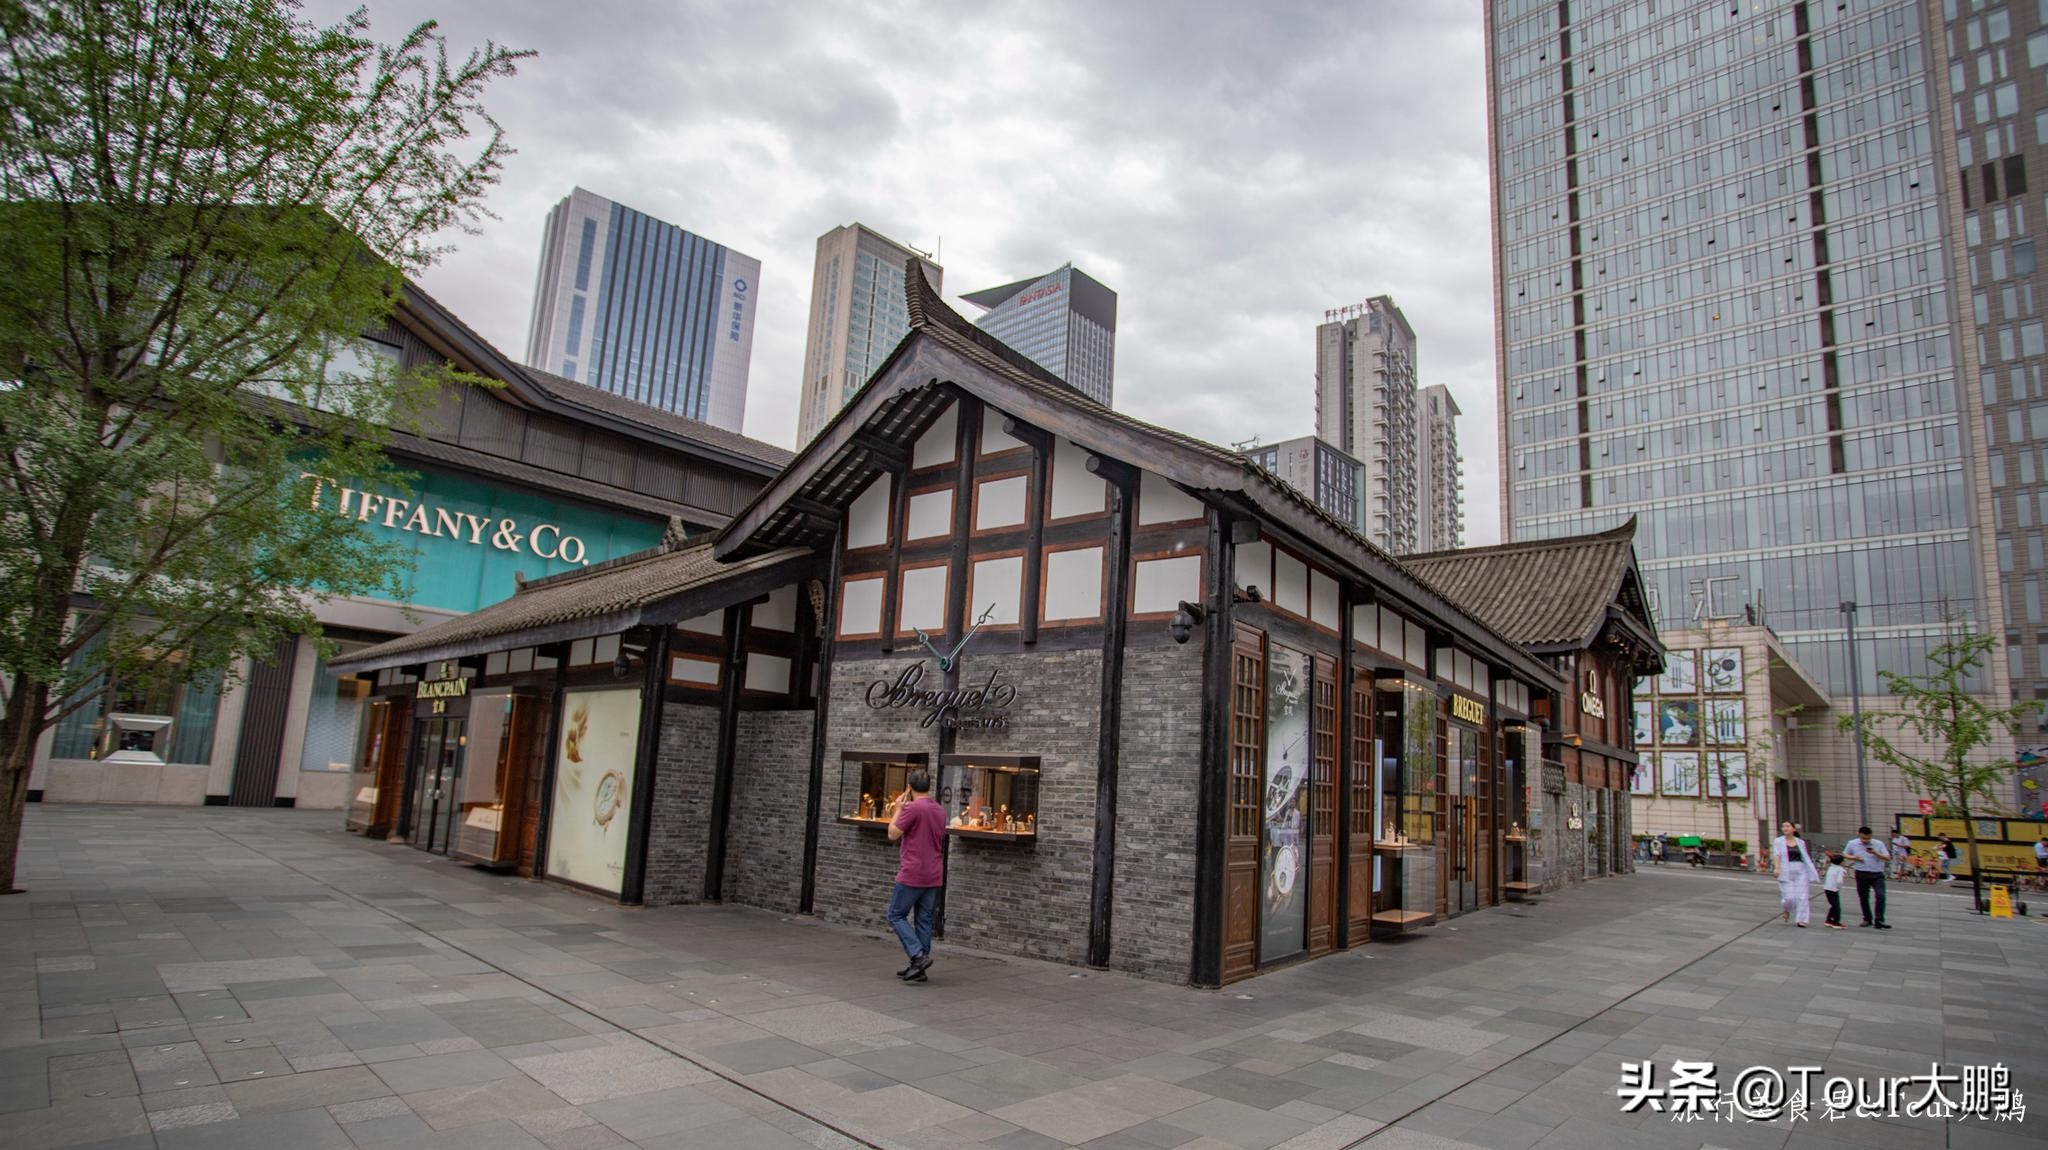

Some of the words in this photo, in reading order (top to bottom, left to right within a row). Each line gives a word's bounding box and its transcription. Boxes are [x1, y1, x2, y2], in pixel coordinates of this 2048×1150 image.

[416, 677, 468, 699] BLANCPAIN
[865, 659, 1018, 729] Breguet
[1453, 693, 1484, 726] BREGUET
[1582, 691, 1605, 719] OMEGA
